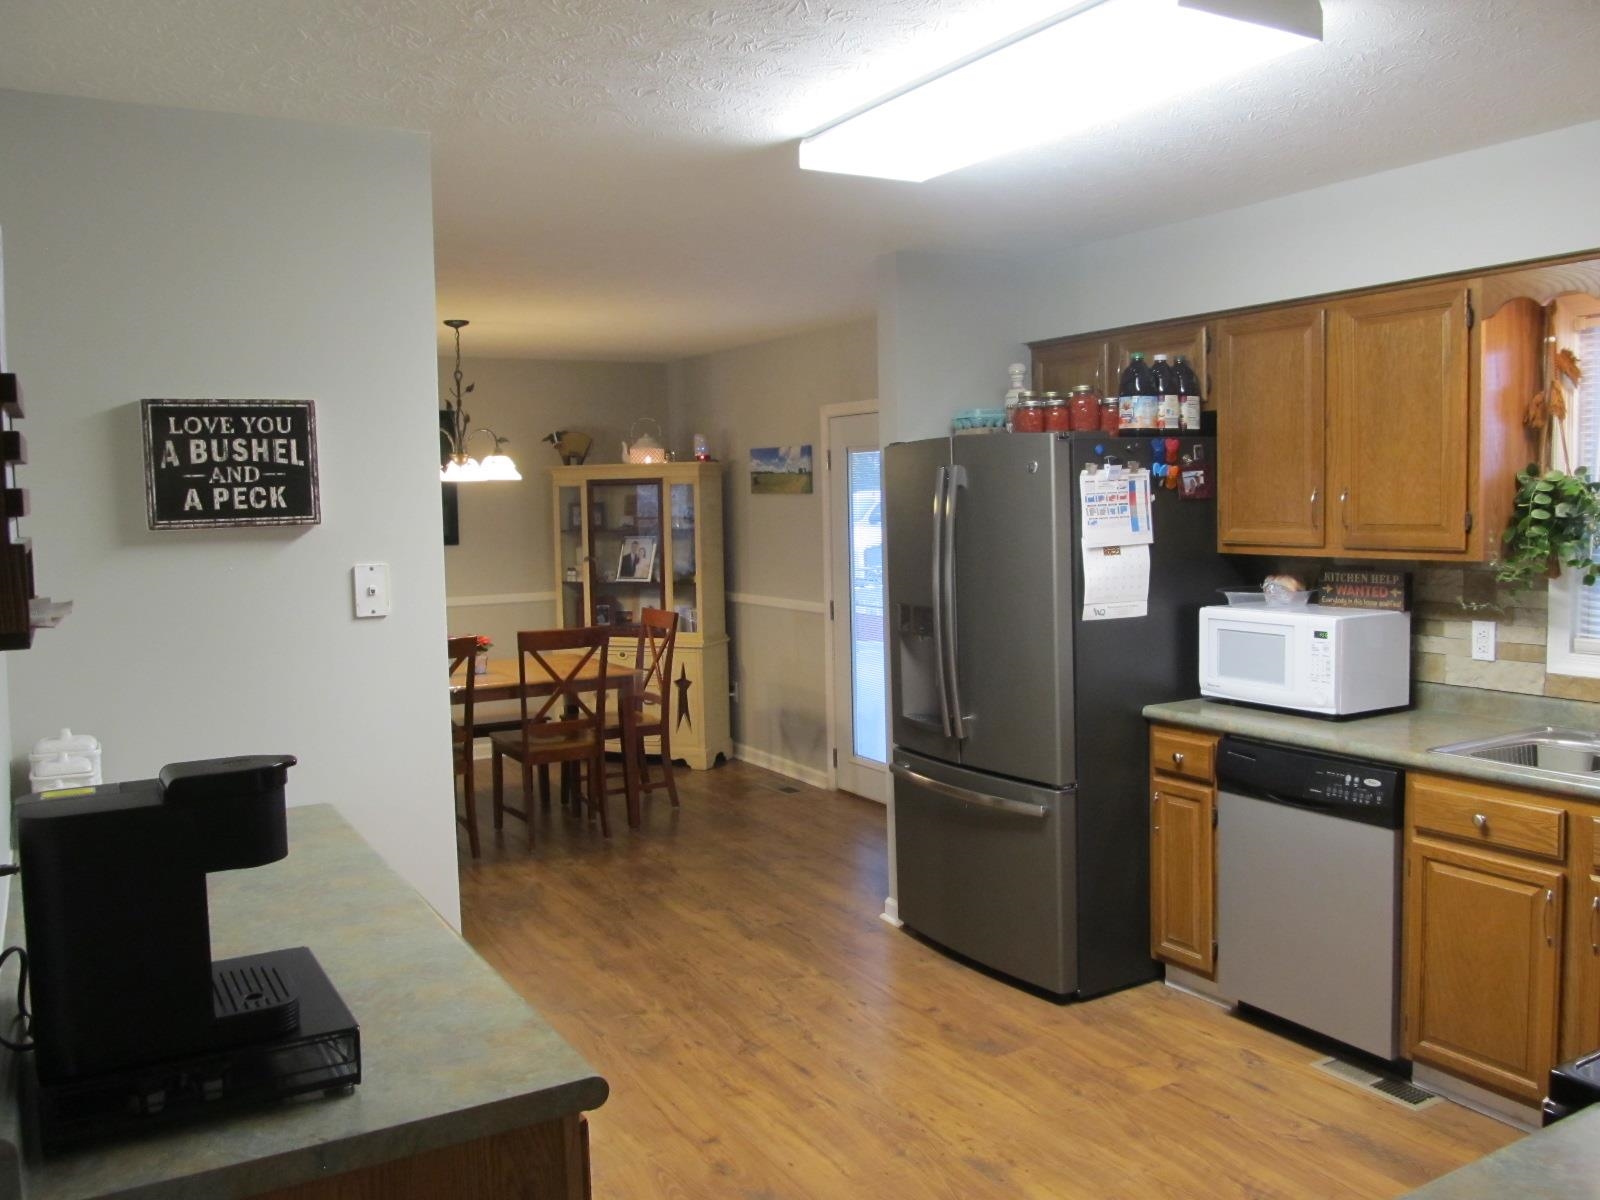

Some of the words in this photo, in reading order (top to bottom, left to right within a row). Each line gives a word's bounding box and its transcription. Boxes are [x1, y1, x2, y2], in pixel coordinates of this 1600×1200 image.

[168, 416, 235, 435] LOVE
[241, 416, 292, 434] YOU
[160, 439, 181, 469] A
[189, 438, 305, 467] BUSHEL
[208, 465, 261, 484] AND
[183, 487, 204, 511] A
[213, 485, 288, 511] PECK
[1324, 571, 1368, 583] KITCHEN
[1371, 574, 1399, 584] HELP
[1335, 584, 1389, 598] WANTED
